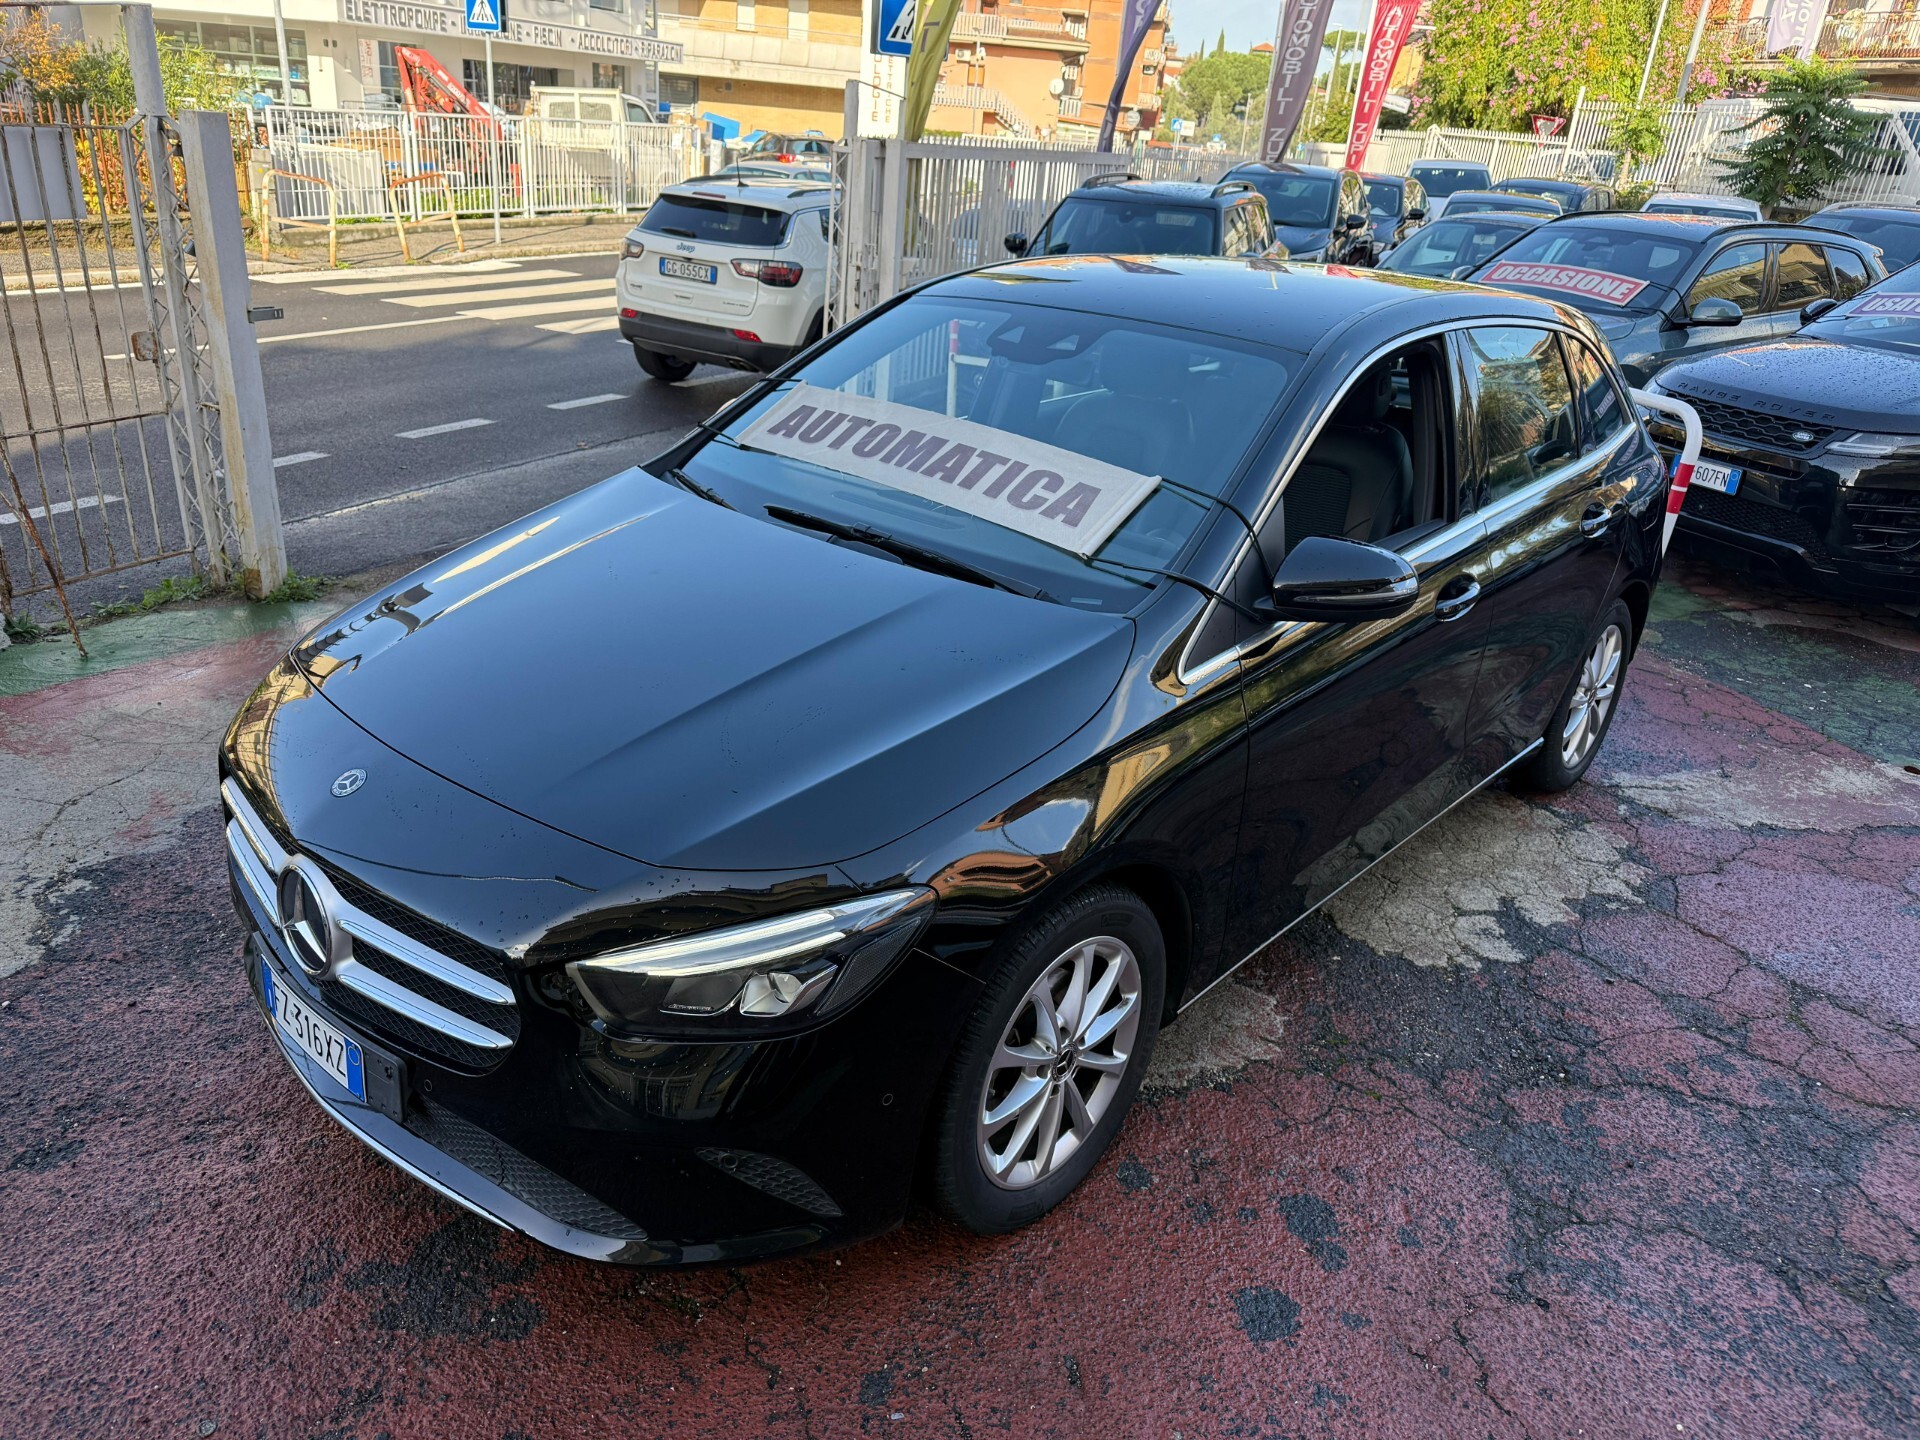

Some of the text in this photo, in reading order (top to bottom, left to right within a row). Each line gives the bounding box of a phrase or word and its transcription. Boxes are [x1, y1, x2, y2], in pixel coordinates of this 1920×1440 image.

[345, 1, 448, 33] ELETTROPOMPE
[1363, 6, 1404, 113] AUTOMOBILI
[1350, 123, 1368, 165] ZUPI
[666, 260, 710, 280] GG 055CX
[1492, 265, 1635, 299] OCCASIONE
[1677, 382, 1837, 422] RANGE ROVER
[766, 404, 1102, 529] AUTOMATICA
[272, 980, 346, 1077] FZ 316XZ
